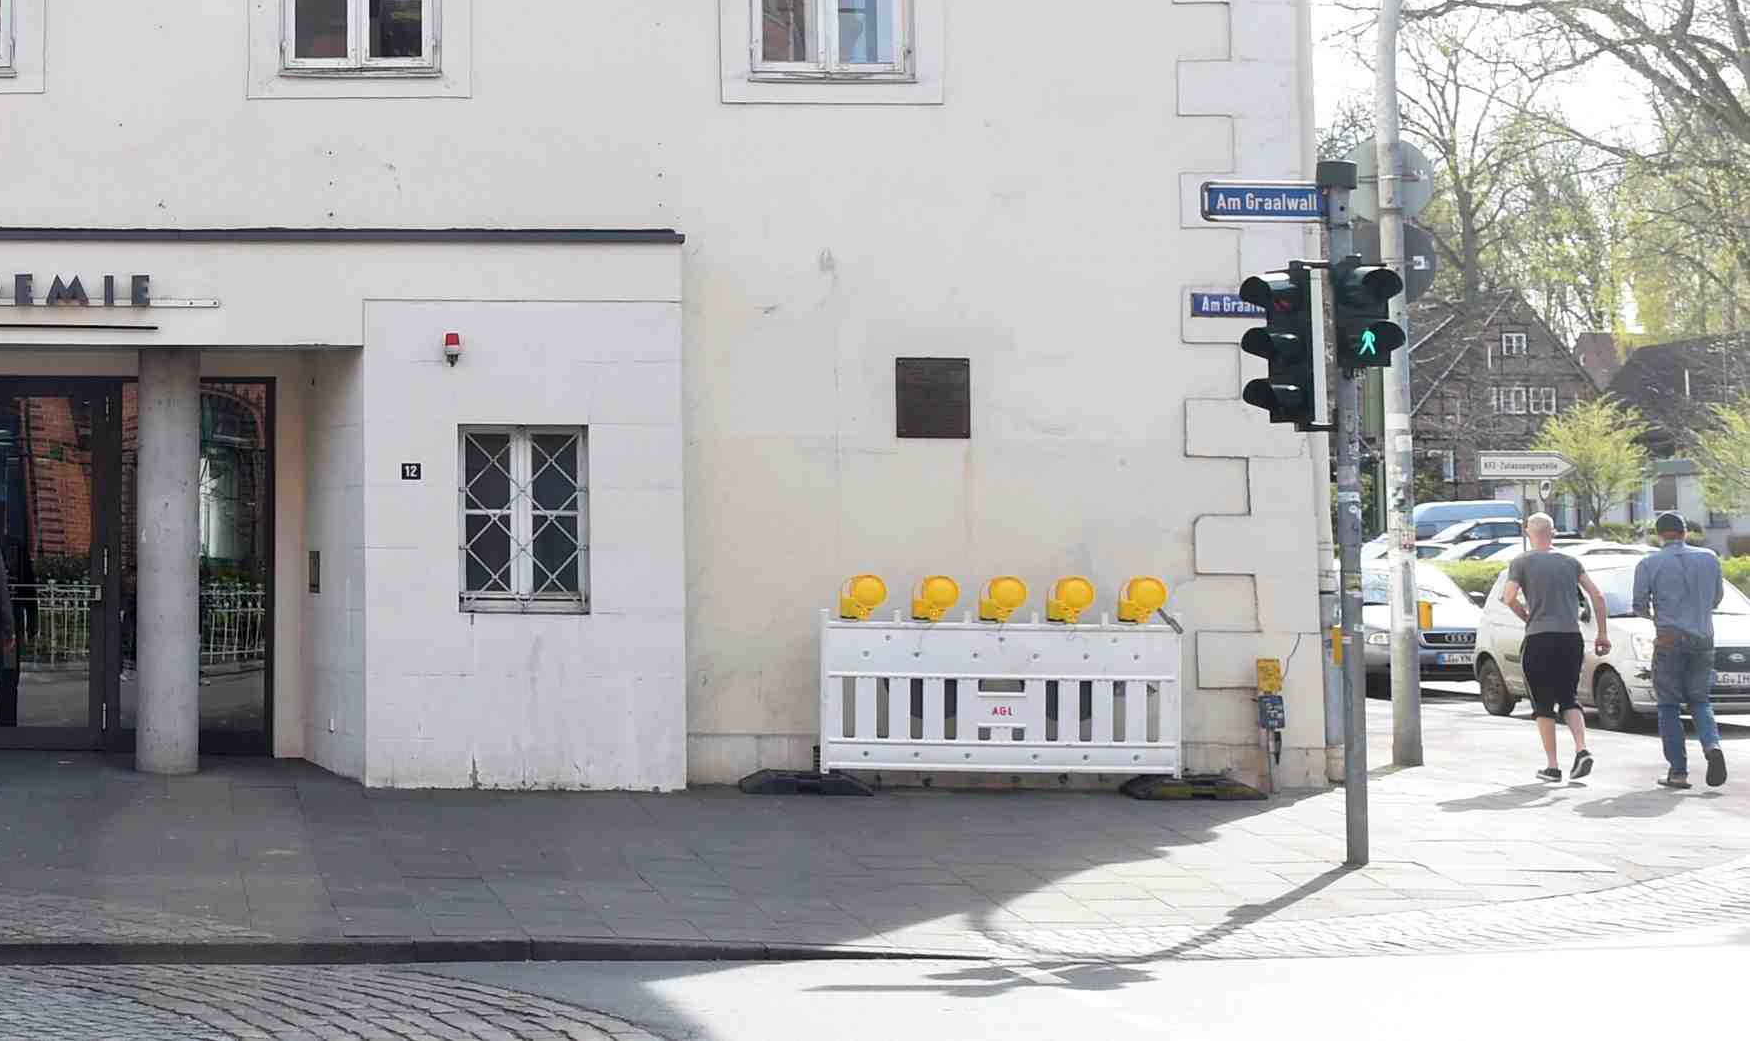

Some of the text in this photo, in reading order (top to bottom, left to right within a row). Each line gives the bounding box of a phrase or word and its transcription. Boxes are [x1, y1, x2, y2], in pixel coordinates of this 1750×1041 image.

[1217, 192, 1317, 211] Am Graalwall
[1201, 295, 1266, 312] Am Graalw
[404, 465, 418, 478] 12
[992, 706, 1012, 716] AGL
